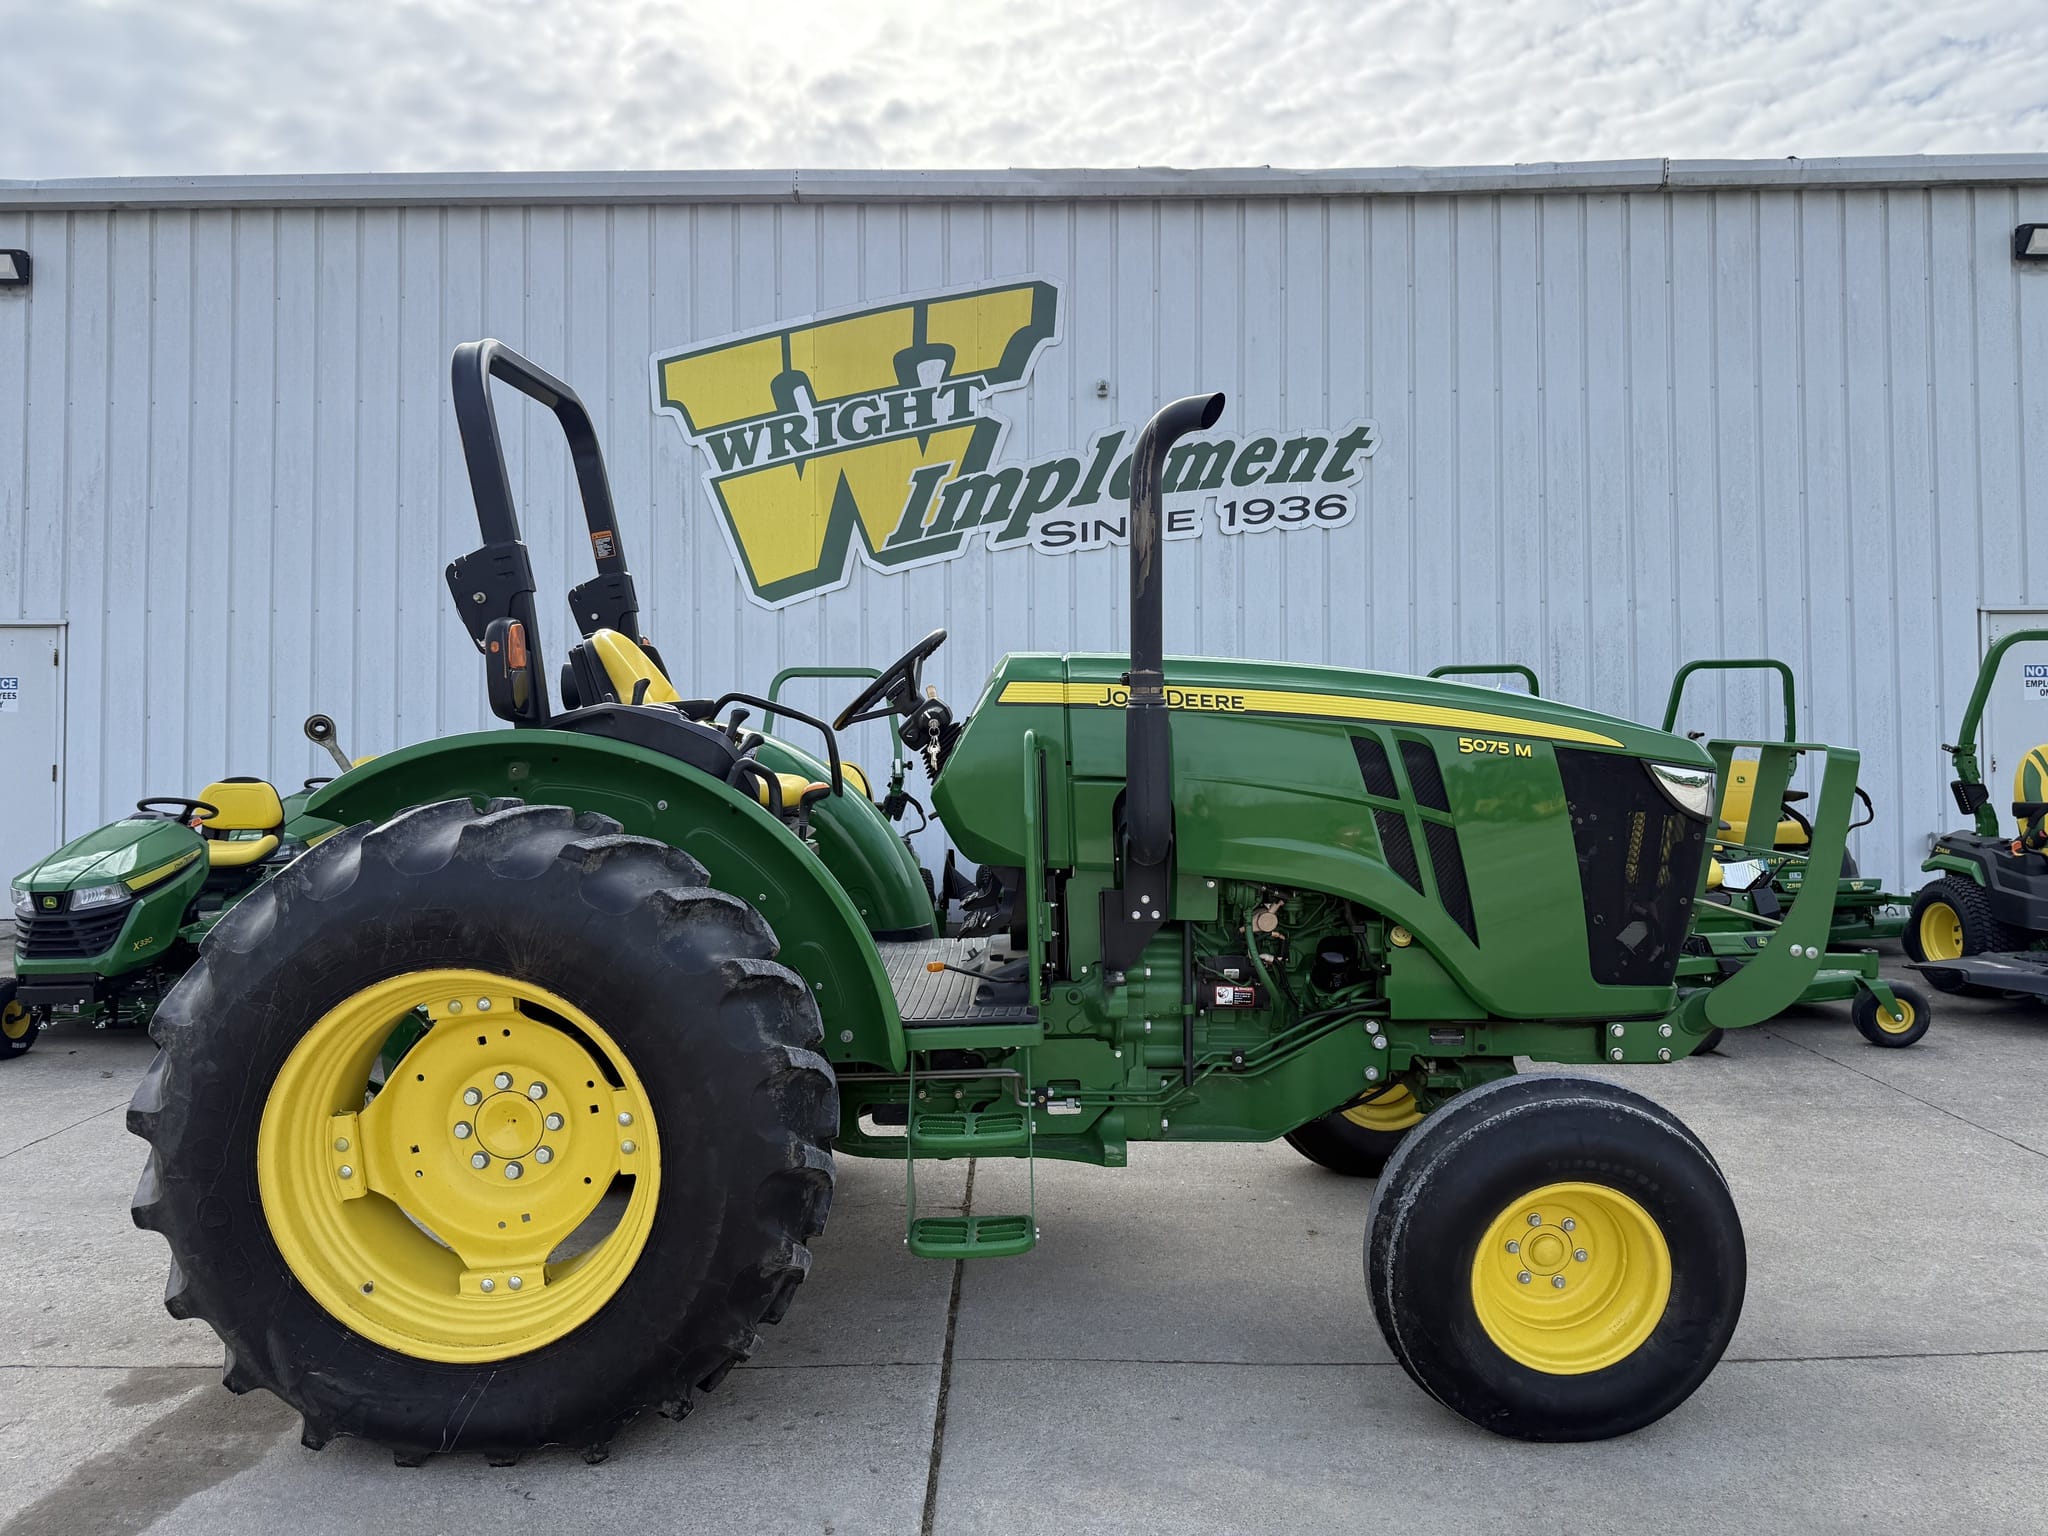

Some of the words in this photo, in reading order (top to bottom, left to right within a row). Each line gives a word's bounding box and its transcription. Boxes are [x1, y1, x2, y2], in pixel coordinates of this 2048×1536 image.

[705, 379, 986, 472] WRIGHT
[1040, 508, 1195, 547] SINE
[1223, 493, 1348, 527] 1936
[1166, 689, 1245, 709] DEERE
[1458, 736, 1510, 755] 5075
[1514, 742, 1532, 758] M
